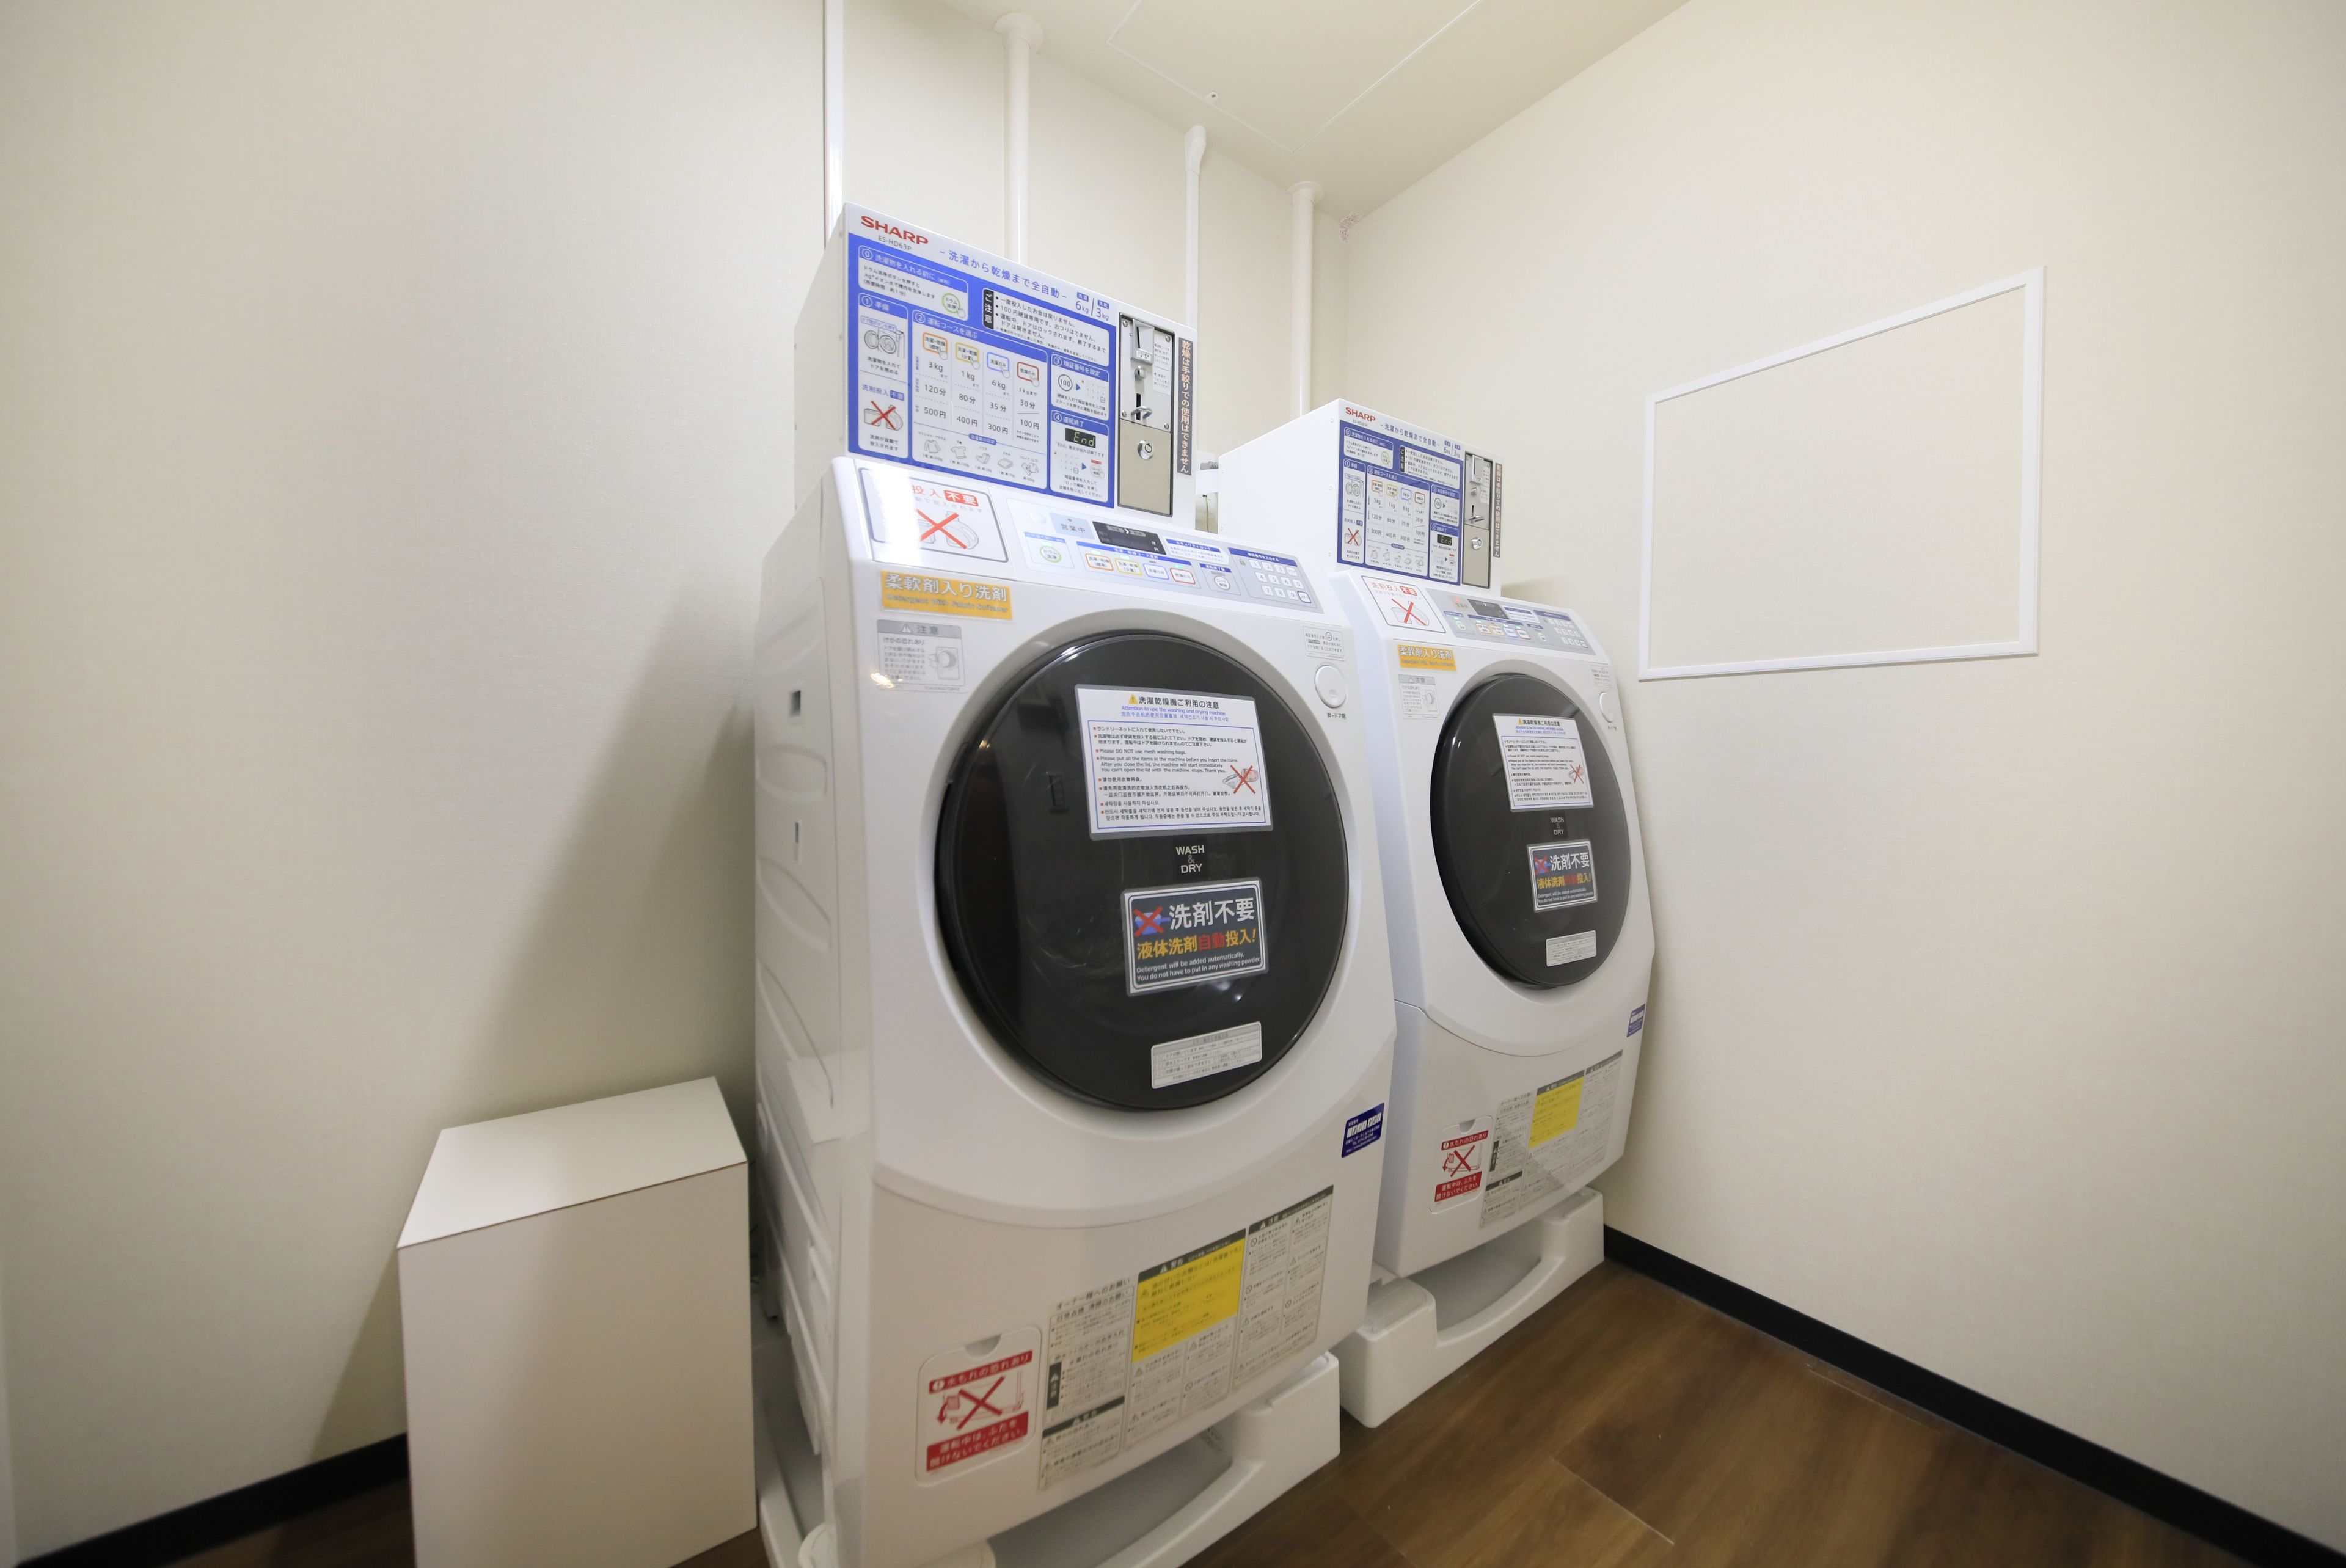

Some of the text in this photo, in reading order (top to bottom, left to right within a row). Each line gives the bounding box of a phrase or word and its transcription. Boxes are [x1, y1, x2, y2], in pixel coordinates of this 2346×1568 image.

[861, 215, 929, 244] SHARP
[878, 235, 912, 251] ES-HD63P
[875, 254, 935, 280] 洗濯物を入れる前に
[984, 293, 993, 324] ご注意
[927, 318, 978, 338] 運転コースを選ぶ
[1001, 321, 1045, 340] ドアは開きません。
[1060, 378, 1070, 387] 100
[862, 384, 888, 396] 洗剤投入
[924, 384, 946, 396] 120分
[959, 394, 976, 404] 80分
[1020, 399, 1035, 409] 30分
[924, 407, 946, 419] 500円
[990, 403, 1006, 412] 35分
[1180, 340, 1191, 473] 乾燥は手絞りでの使用はできません
[957, 416, 978, 427] 400円
[1345, 407, 1376, 422] SHARP
[988, 424, 1008, 434] 300円
[1020, 419, 1039, 430] 100円
[1073, 432, 1095, 447] End
[912, 485, 978, 506] 投入 不要
[1060, 523, 1086, 533] 営業中
[1175, 541, 1211, 551] セキュリティロック
[1441, 536, 1452, 545] End
[885, 573, 1007, 602] 柔軟剤入り洗剤
[917, 625, 939, 635] 注意
[1400, 646, 1453, 660] 柔軟剤入り洗剤
[1139, 696, 1219, 709] 洗濯乾燥機ご利用の注意
[1176, 845, 1205, 855] WASH
[1188, 855, 1194, 864] &
[1550, 852, 1590, 872] 洗剤不要
[1180, 863, 1202, 873] DRY
[1168, 897, 1255, 930] 洗剤不要
[1136, 928, 1256, 960] 液体洗剤自動投入!
[1136, 963, 1167, 974] Detergent
[1208, 952, 1244, 963] automatically.
[1191, 966, 1201, 975] put
[1219, 960, 1241, 970] washing
[1241, 957, 1261, 967] powder.
[1057, 1279, 1130, 1311] オーナー様へのお願い
[948, 1354, 1028, 1387] 水もれの恐れあり
